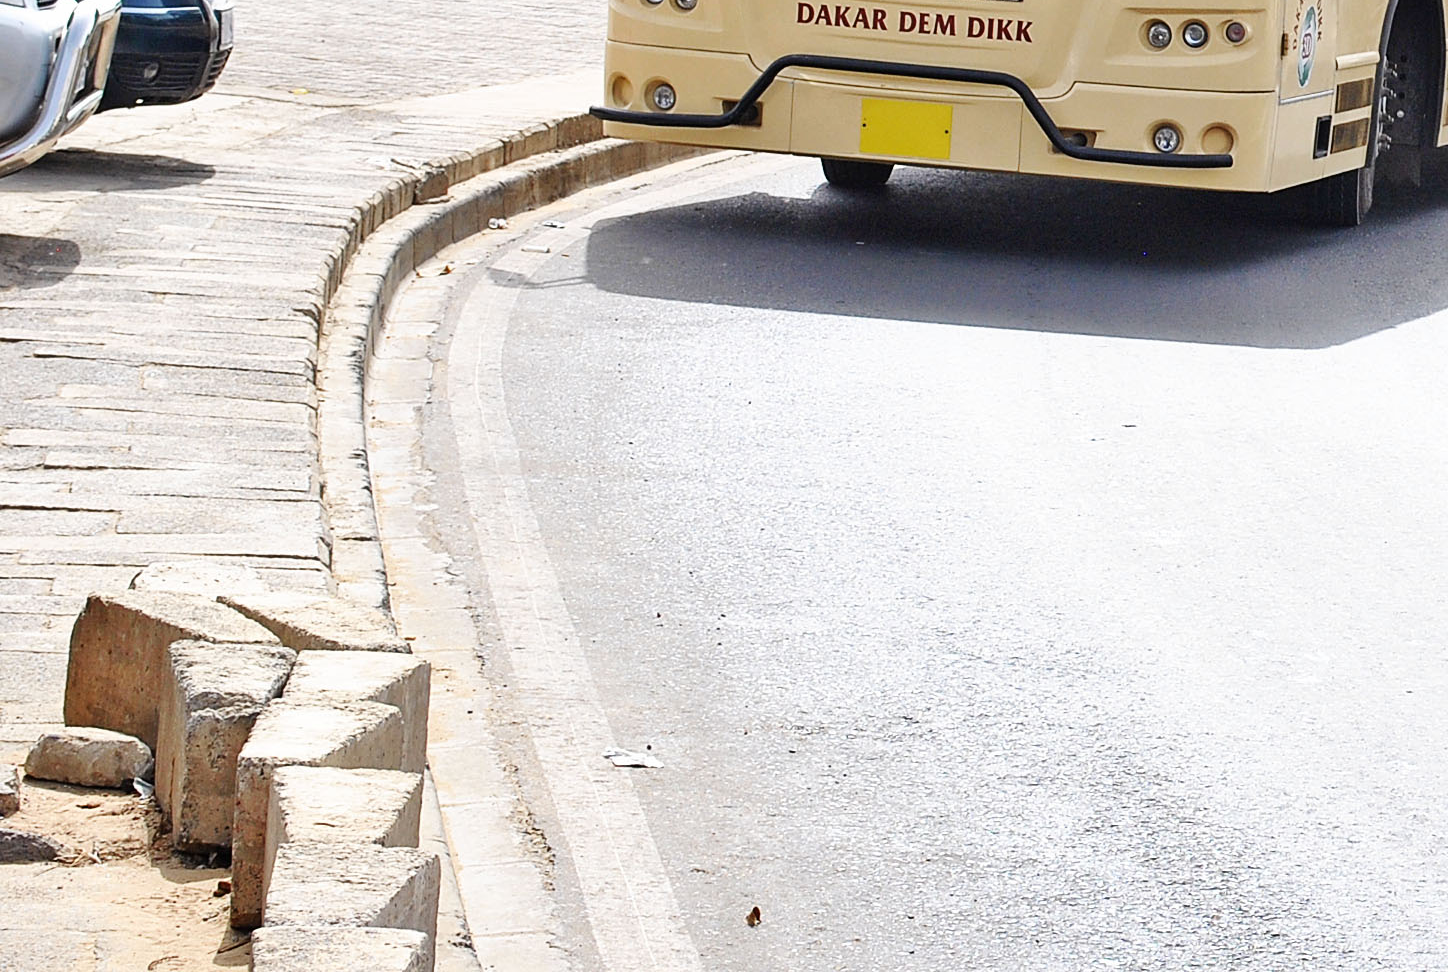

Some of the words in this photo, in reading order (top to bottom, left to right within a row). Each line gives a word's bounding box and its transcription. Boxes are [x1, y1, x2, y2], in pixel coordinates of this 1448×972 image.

[796, 2, 888, 31] DAKAR
[898, 10, 957, 37] DEM
[966, 16, 1034, 43] DIKK
